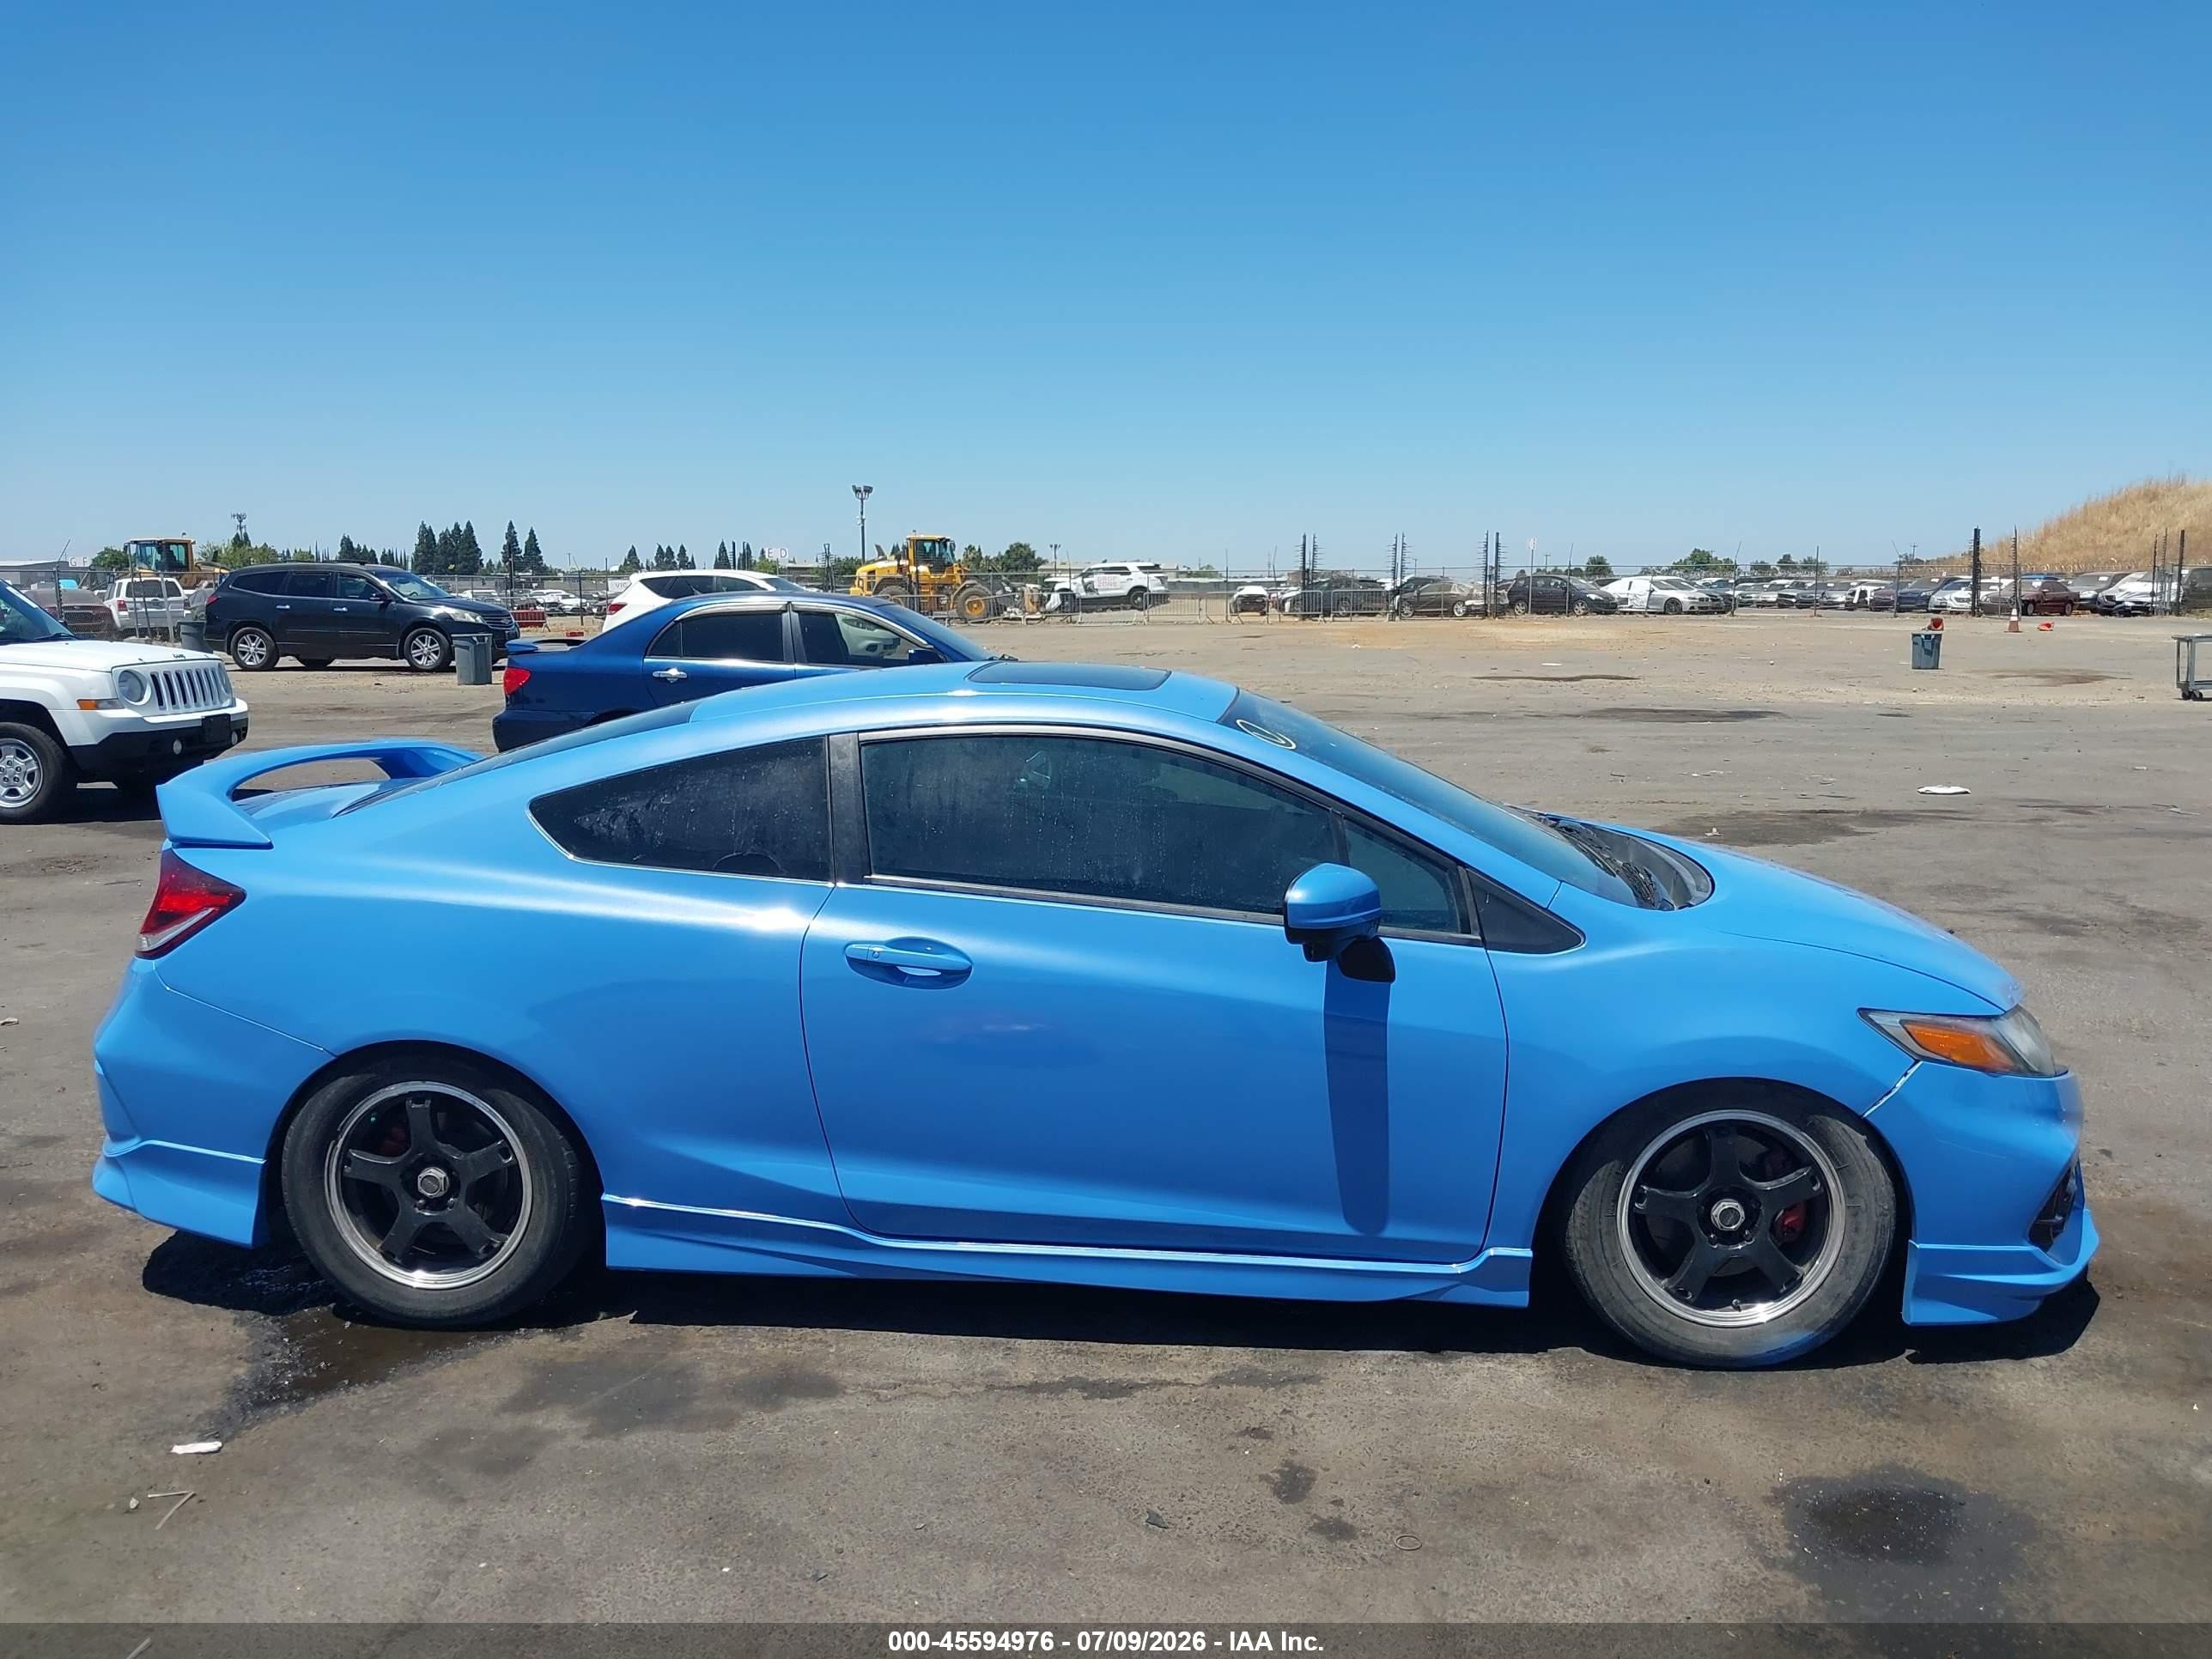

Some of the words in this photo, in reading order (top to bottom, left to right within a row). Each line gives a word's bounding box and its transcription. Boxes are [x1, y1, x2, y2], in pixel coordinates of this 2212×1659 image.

[768, 548, 773, 558] E
[780, 548, 787, 558] D
[70, 556, 77, 567] G
